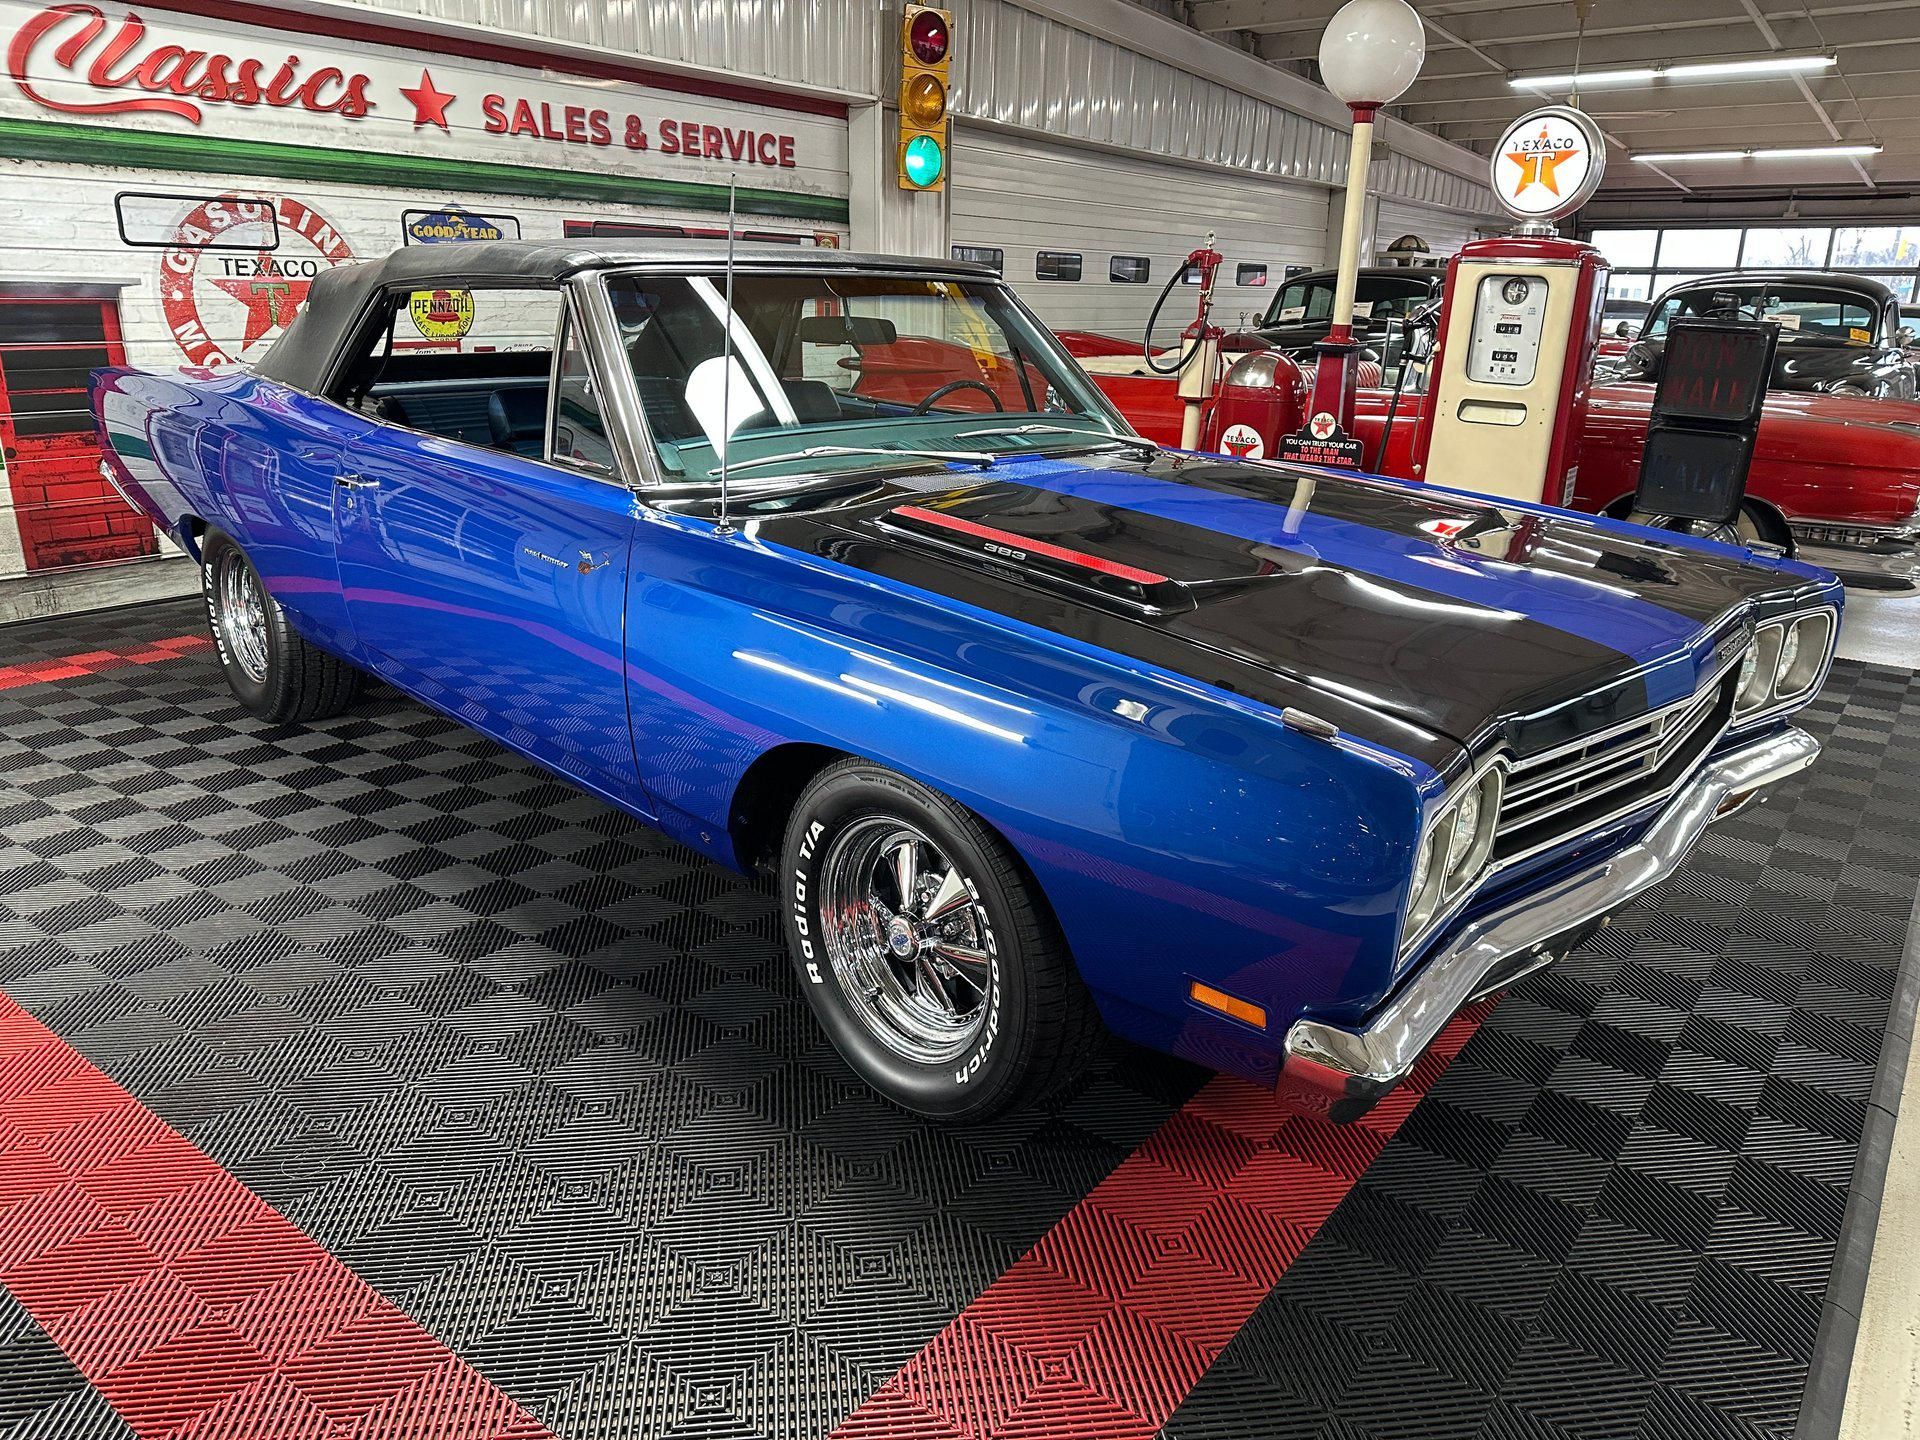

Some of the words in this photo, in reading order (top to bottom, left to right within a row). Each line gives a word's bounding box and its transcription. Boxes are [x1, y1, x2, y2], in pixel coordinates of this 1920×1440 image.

[7, 3, 377, 125] Classics
[482, 93, 612, 146] SALES
[623, 113, 648, 150] &
[659, 118, 797, 168] SERVICE
[1513, 138, 1574, 152] TEXACO
[218, 257, 318, 278] TEXACO
[414, 297, 471, 314] PENNZOIL
[415, 315, 431, 335] SAFE
[1663, 375, 1748, 413] WALK
[1226, 434, 1257, 444] TEXACO
[1344, 442, 1357, 450] CAR
[1283, 452, 1299, 460] THAT
[1300, 454, 1323, 462] WEARS
[1323, 448, 1339, 456] MAN
[983, 542, 1027, 561] 383
[205, 563, 213, 590] T/A
[207, 596, 231, 666] Radial
[798, 819, 826, 860] T/A
[793, 869, 824, 984] Radial
[955, 876, 1001, 1085] BFGoodrich
